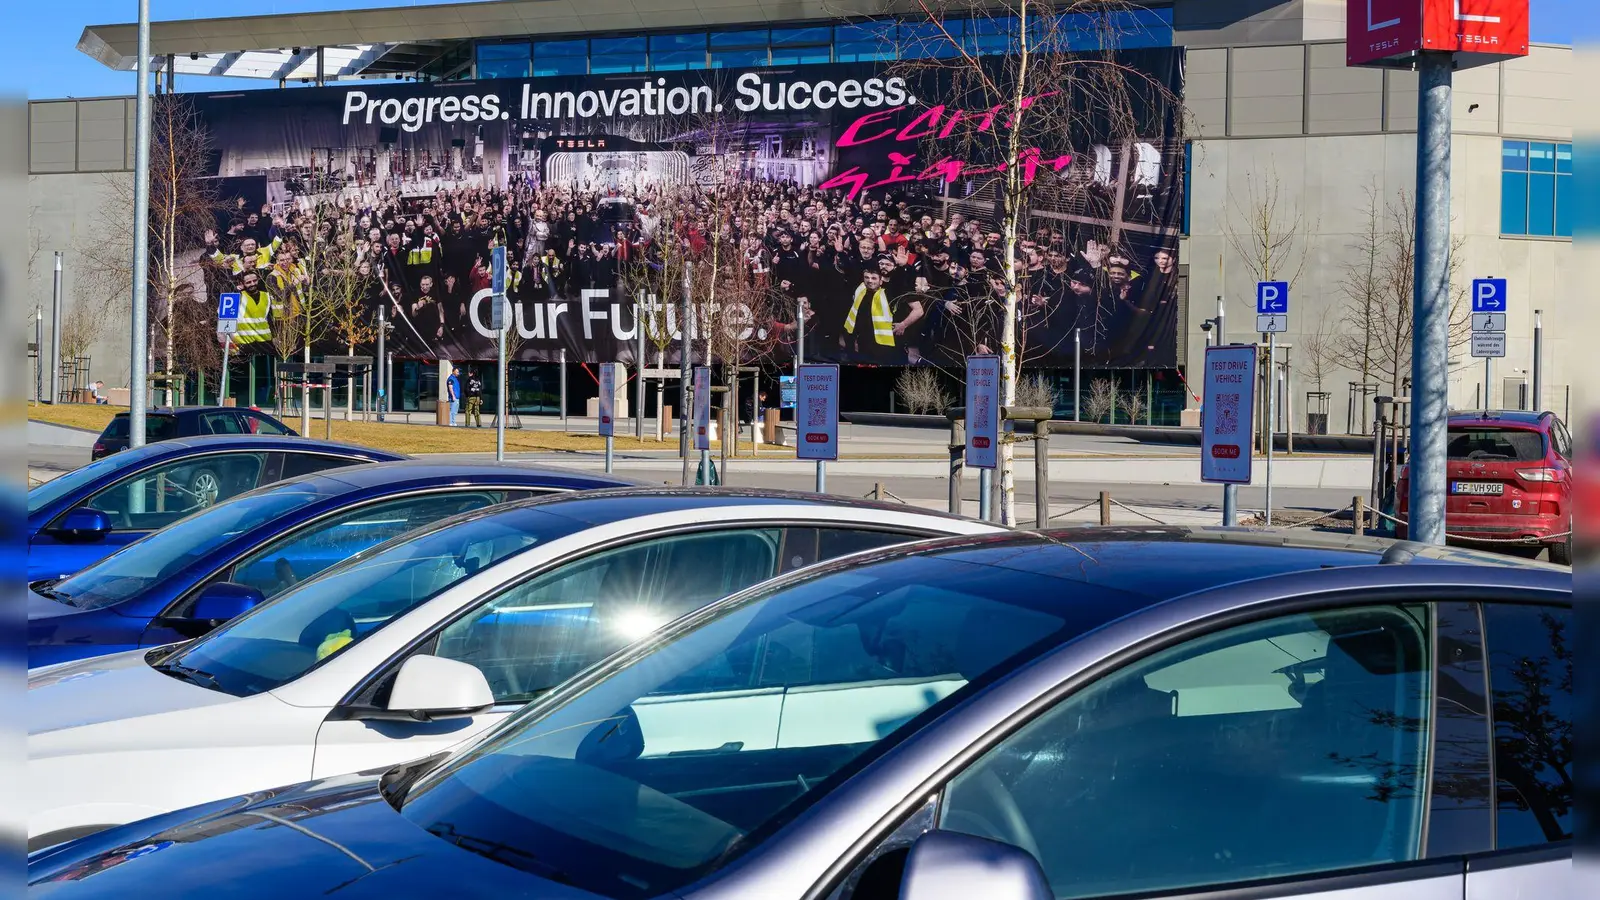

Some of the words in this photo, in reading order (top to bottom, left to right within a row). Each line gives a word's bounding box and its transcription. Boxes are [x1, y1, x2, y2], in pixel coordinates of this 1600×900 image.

[1456, 34, 1499, 44] TESLA
[1369, 37, 1400, 52] TESLA
[342, 90, 510, 133] Progress.
[520, 77, 723, 120] Innovation.
[734, 73, 917, 112] Success.
[556, 139, 605, 148] TESLA
[1262, 286, 1279, 310] P
[1477, 283, 1496, 308] P
[222, 296, 234, 316] P
[469, 288, 568, 340] Our
[580, 288, 768, 340] Future.
[1211, 361, 1226, 370] TEST
[1227, 361, 1248, 370] DRIVE
[971, 368, 981, 376] TEST
[981, 368, 994, 376] DRIVE
[1215, 374, 1242, 383] VEHICLE
[1229, 448, 1237, 456] ME
[1457, 483, 1468, 492] FF
[1473, 483, 1485, 492] VH
[1486, 484, 1503, 493] 90E
